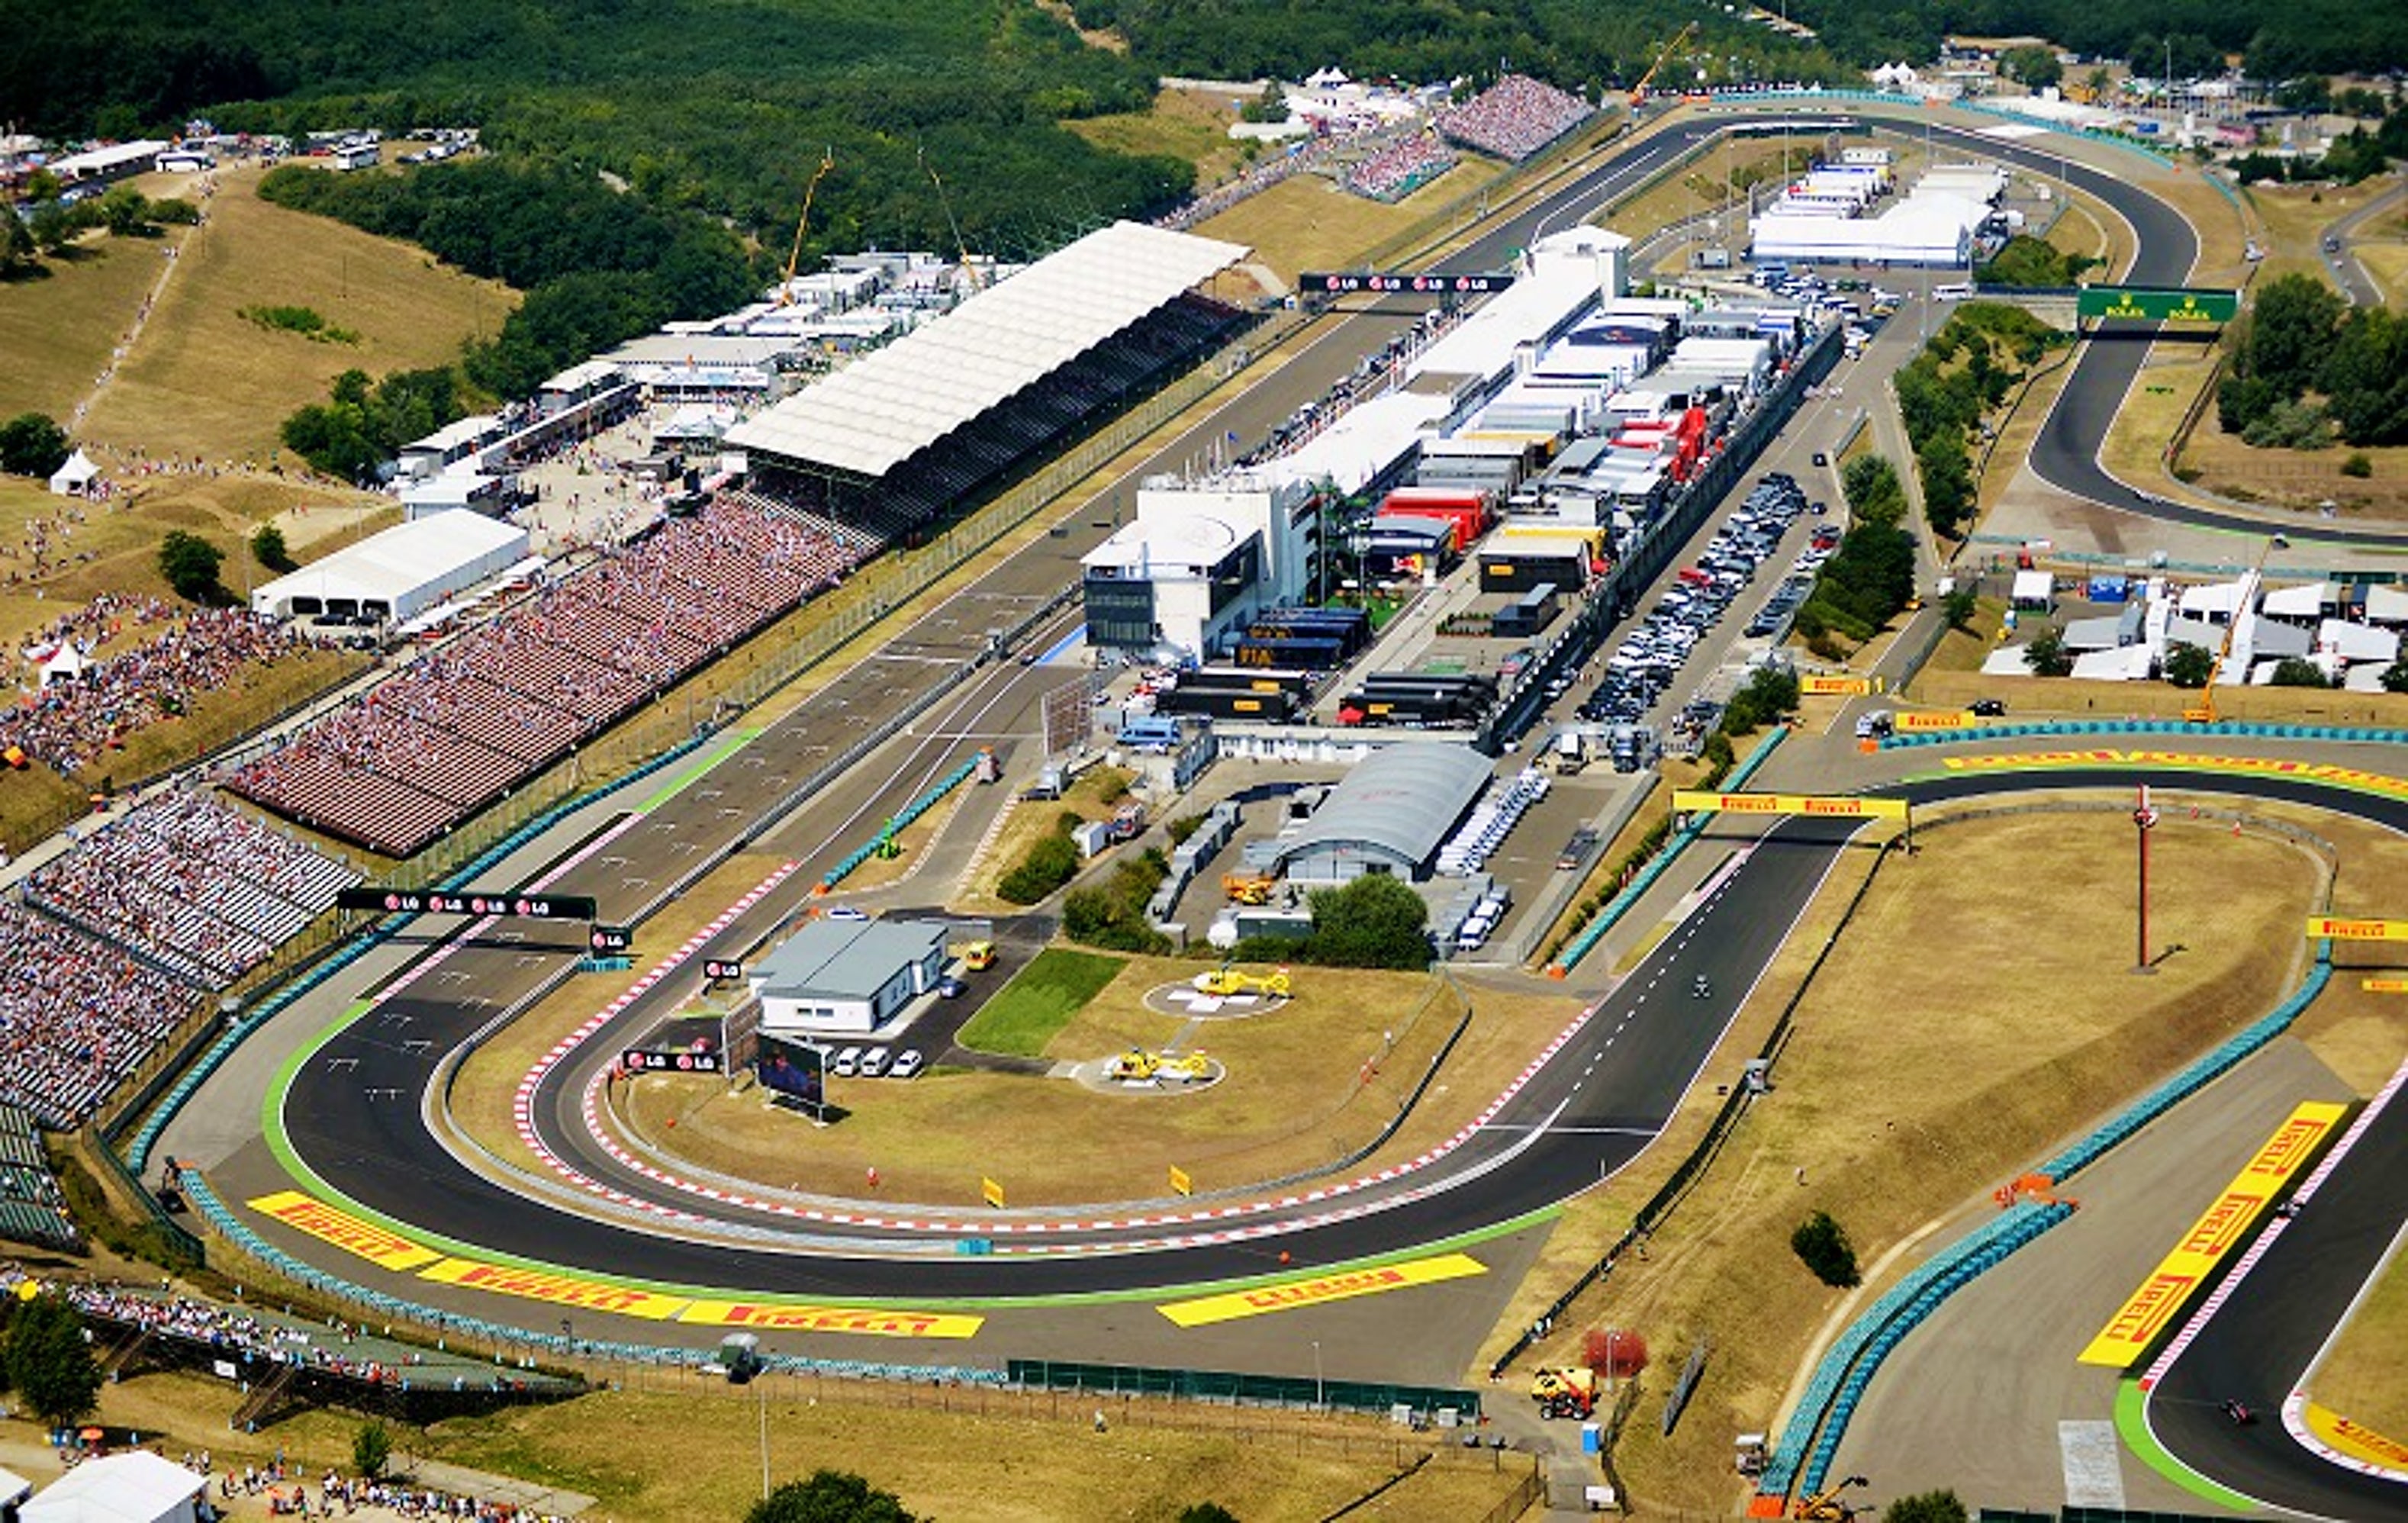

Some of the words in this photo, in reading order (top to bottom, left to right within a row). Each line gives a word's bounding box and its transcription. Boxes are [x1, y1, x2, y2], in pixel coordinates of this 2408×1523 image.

[1341, 278, 1358, 290] LG
[1384, 279, 1401, 290] LG
[1471, 279, 1488, 290] LG
[2106, 306, 2146, 318] ROLEX
[2168, 309, 2210, 321] ROLEX
[1721, 797, 1776, 810] PIRELLI
[1804, 800, 1861, 813] PIRELLI
[402, 897, 420, 910] LG
[445, 899, 463, 910] LG
[487, 901, 506, 912] LG
[532, 903, 549, 915] LG
[2323, 920, 2384, 935] PIRELLI
[607, 935, 624, 946] LG
[722, 965, 739, 976] LG
[646, 1055, 666, 1067] LG
[694, 1056, 714, 1069] LG
[2251, 1119, 2326, 1176] PIRELLI
[275, 1203, 414, 1257] PIRELLI
[2183, 1193, 2264, 1257] PIRELLI
[459, 1267, 649, 1309] PIRELLI
[2106, 1273, 2197, 1343] PIRELLI
[723, 1306, 940, 1331] PIRELLI
